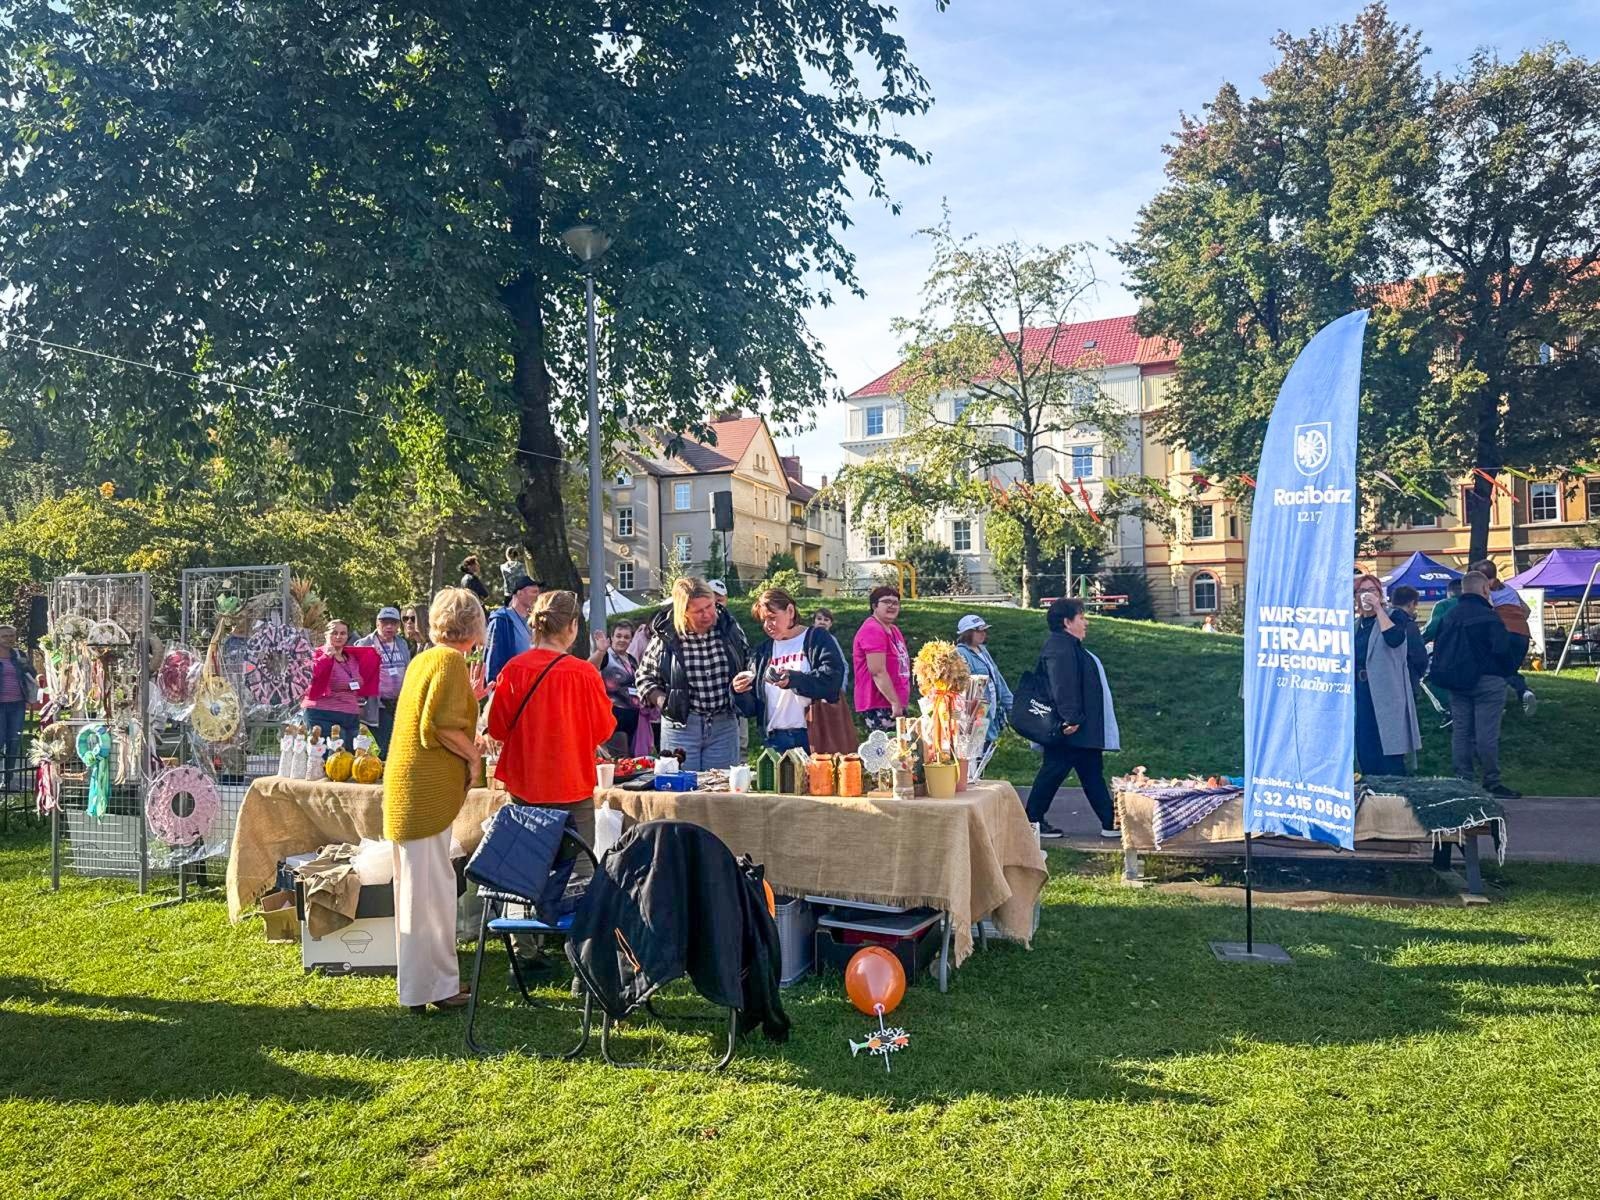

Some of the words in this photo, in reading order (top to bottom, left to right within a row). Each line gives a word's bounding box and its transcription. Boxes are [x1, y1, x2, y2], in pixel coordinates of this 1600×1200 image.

[1274, 484, 1352, 506] Racibórz
[1297, 511, 1322, 524] 1217
[1258, 626, 1350, 655] TERAPII
[1277, 677, 1288, 687] w
[1290, 674, 1351, 694] Raciborzu
[1263, 791, 1283, 806] 32
[1285, 794, 1312, 811] 415
